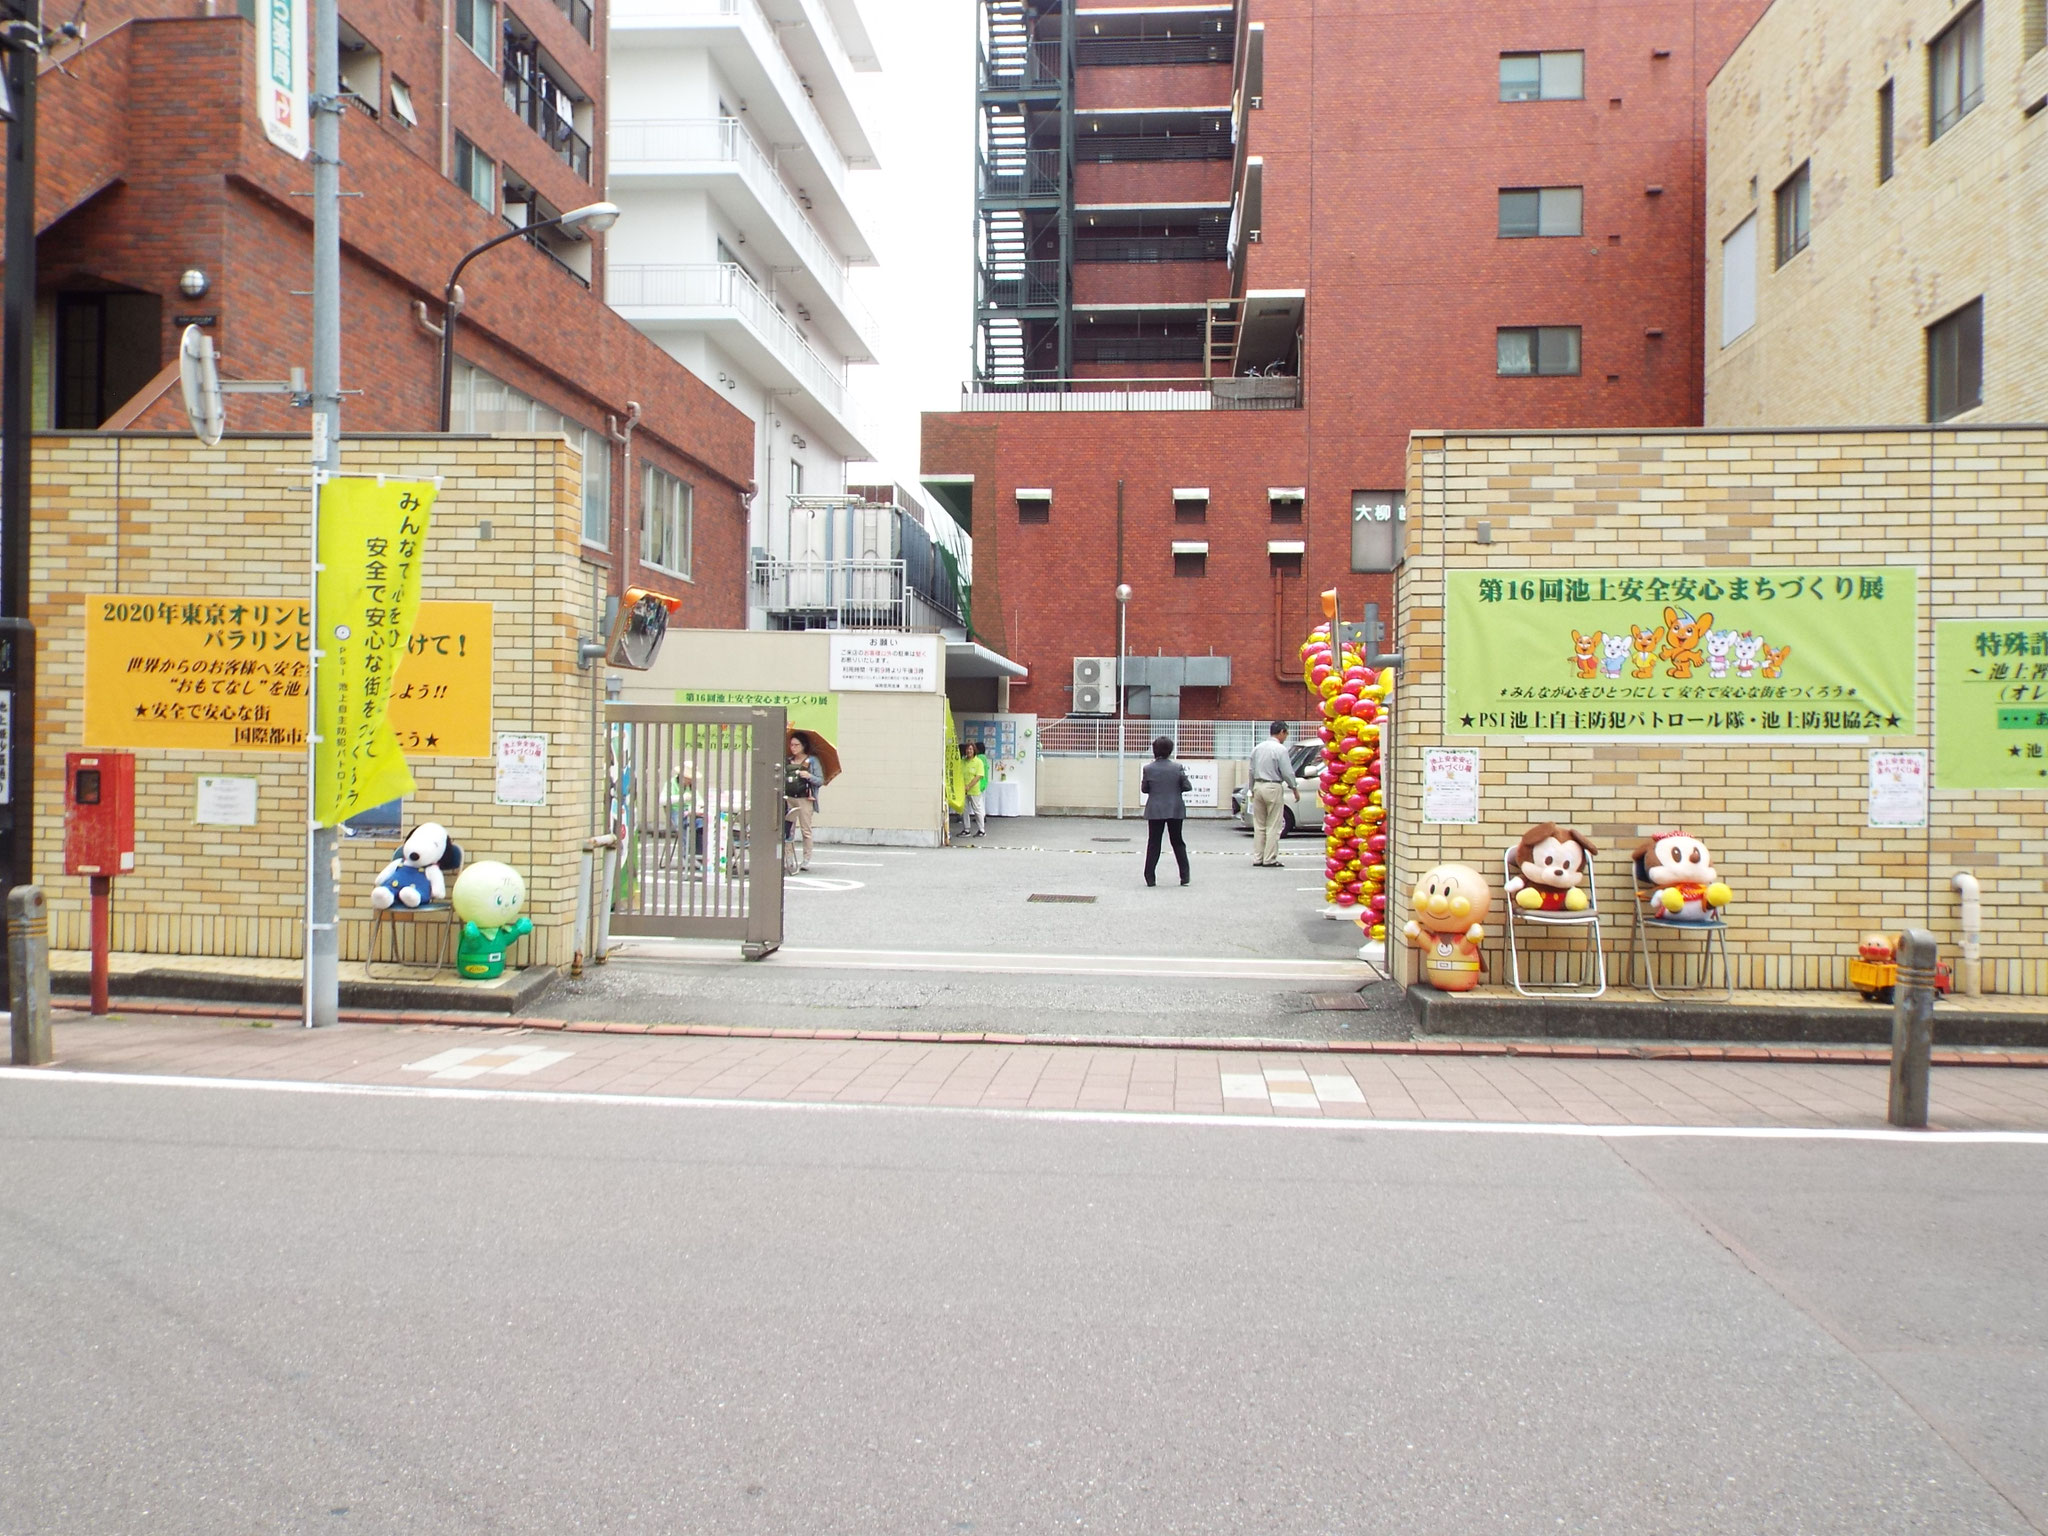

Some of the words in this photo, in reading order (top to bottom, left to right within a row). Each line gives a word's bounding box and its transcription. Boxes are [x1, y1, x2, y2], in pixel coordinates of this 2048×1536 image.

[1479, 576, 1884, 603] 第16回池上安全安心まちづくり展
